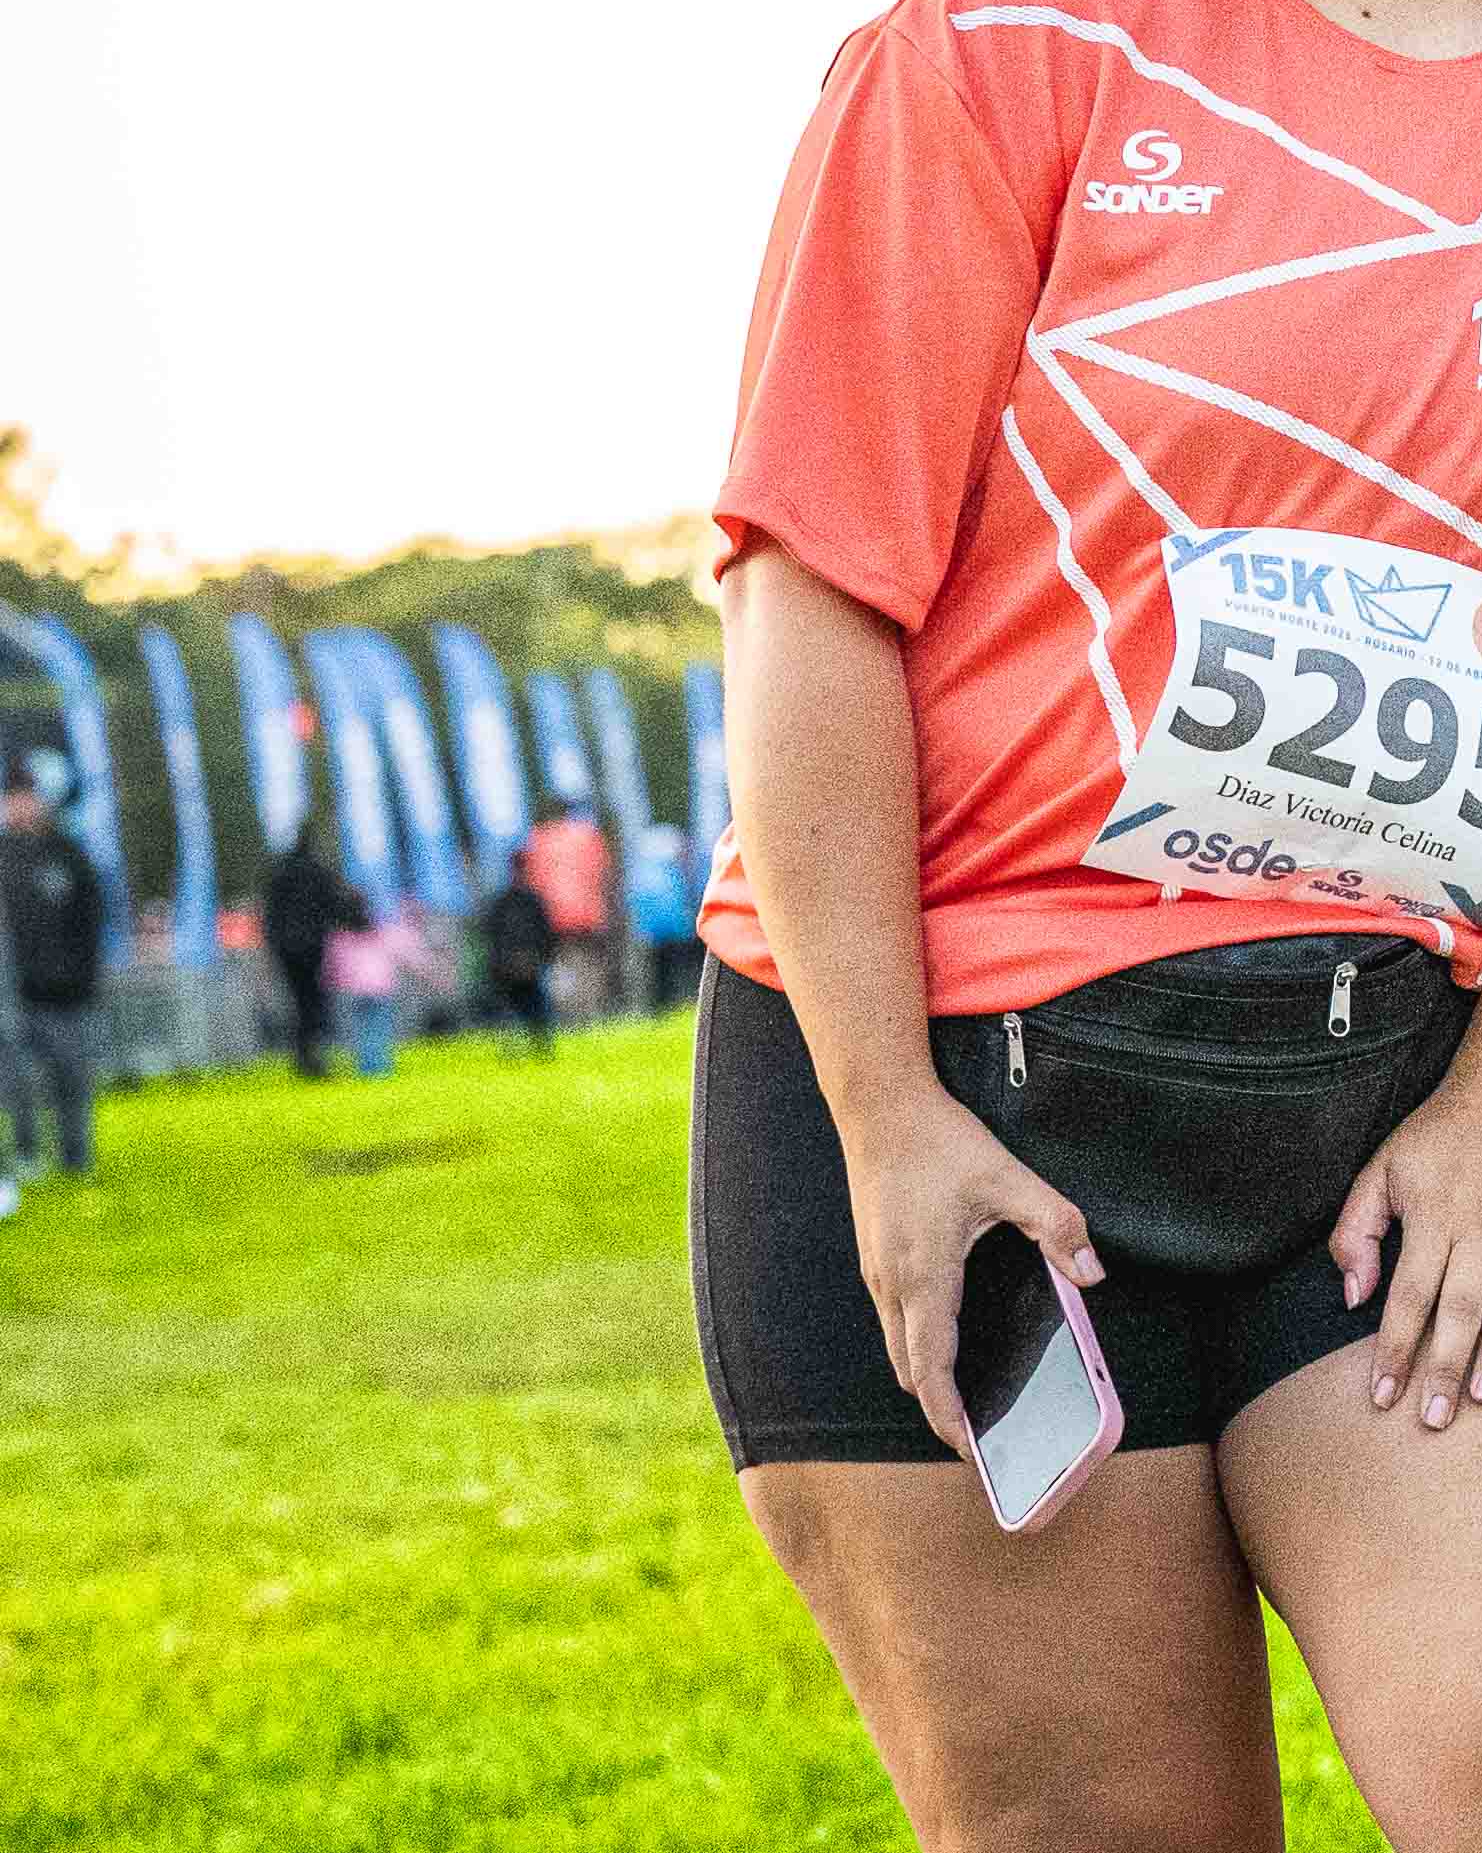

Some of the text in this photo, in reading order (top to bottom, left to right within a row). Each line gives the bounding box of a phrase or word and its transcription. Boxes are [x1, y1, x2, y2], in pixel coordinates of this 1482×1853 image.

[1220, 552, 1335, 617] 15K
[1364, 635, 1416, 659] ROSARIO
[1216, 774, 1457, 862] Diaz Victoria Celina
[1163, 829, 1297, 881] osde
